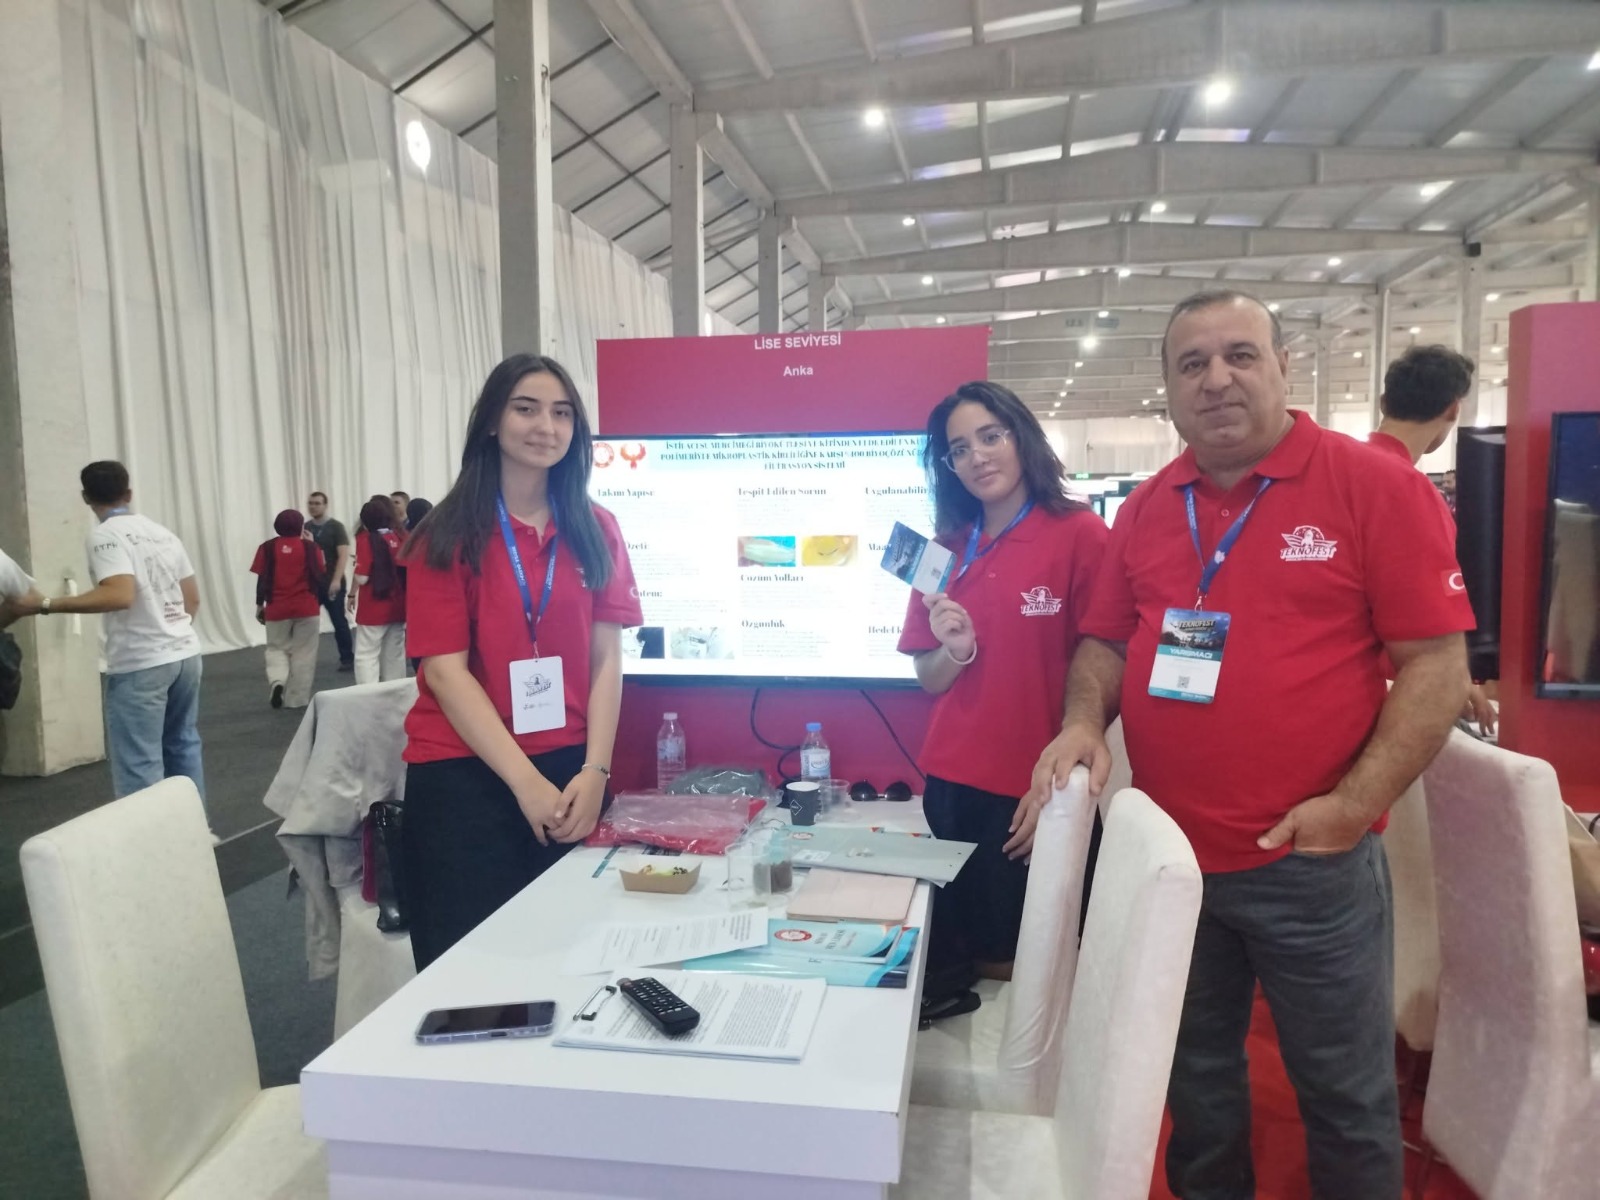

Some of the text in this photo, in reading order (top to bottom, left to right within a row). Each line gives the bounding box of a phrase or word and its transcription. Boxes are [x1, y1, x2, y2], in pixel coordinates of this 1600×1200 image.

[754, 332, 841, 350] LİSE SEVİYESİ
[783, 365, 814, 377] Anka
[738, 487, 827, 498] Tespit Edilen Sorun
[1280, 546, 1336, 558] TEKNOFEST
[1021, 602, 1061, 613] TEKNOFEST
[1179, 620, 1216, 629] TEKNOFEST
